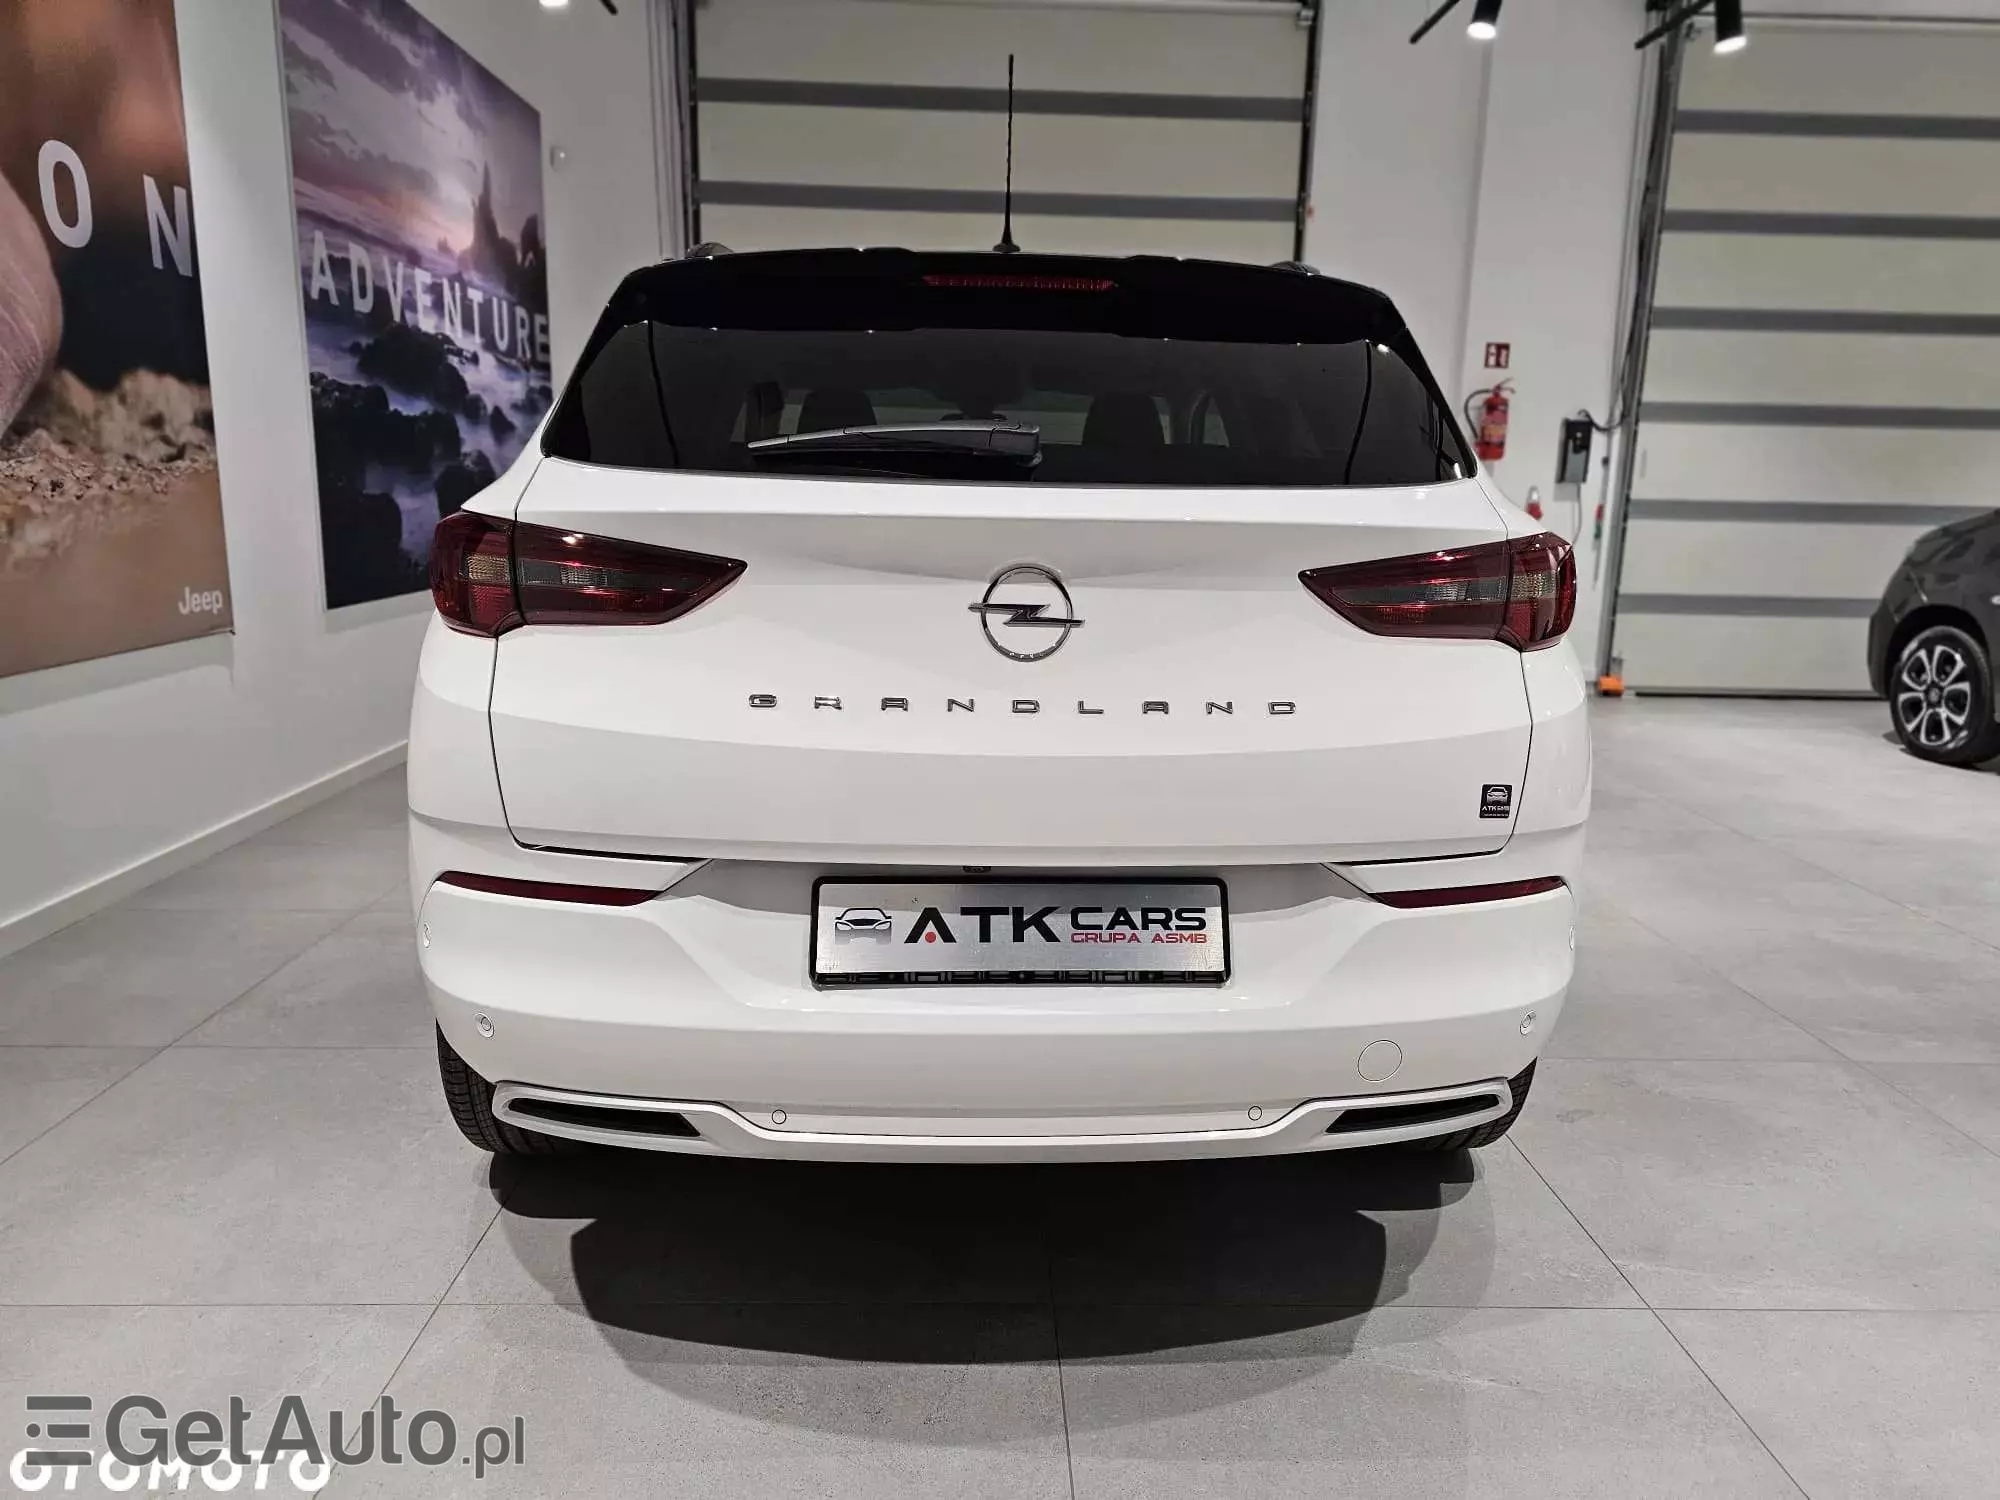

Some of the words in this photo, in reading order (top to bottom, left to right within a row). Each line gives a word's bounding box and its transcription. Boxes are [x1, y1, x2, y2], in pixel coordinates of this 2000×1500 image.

[310, 231, 550, 363] ADVENTURE
[178, 586, 223, 615] Jeep
[748, 694, 1296, 715] GRANDLAND
[904, 906, 1061, 943] ATK
[1070, 907, 1207, 931] CARS
[1070, 932, 1141, 944] GRUPA
[1153, 932, 1208, 944] ASMB
